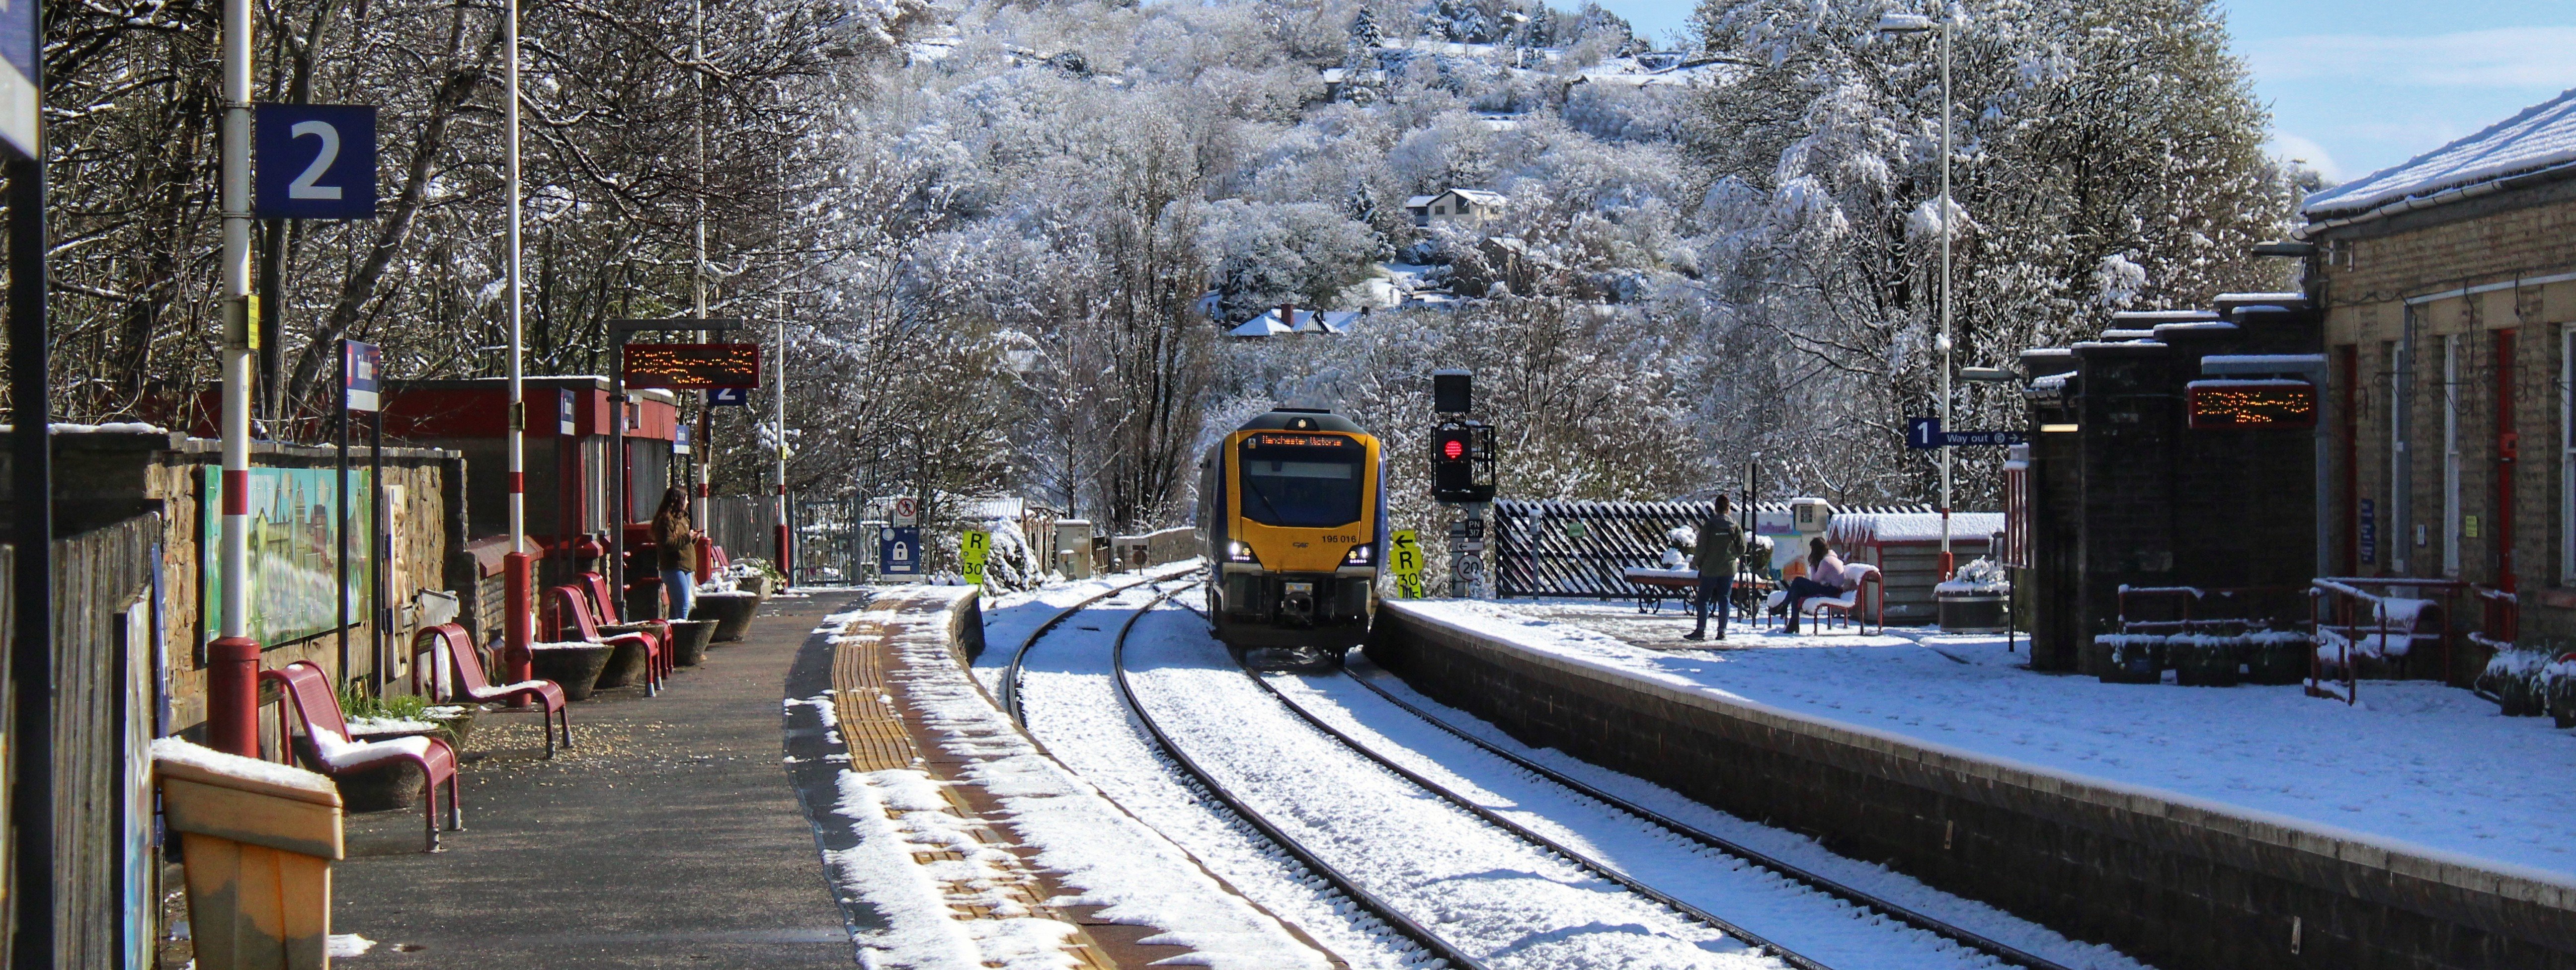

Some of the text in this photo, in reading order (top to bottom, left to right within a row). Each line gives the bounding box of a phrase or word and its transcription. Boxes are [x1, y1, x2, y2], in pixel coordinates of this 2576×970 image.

[289, 121, 342, 200] 2
[1917, 422, 1928, 444] 1
[1947, 434, 1967, 444] Way
[970, 533, 983, 549] R
[1399, 551, 1413, 569] R
[966, 562, 982, 575] 30
[1463, 562, 1479, 574] 20
[1399, 573, 1418, 586] 30
